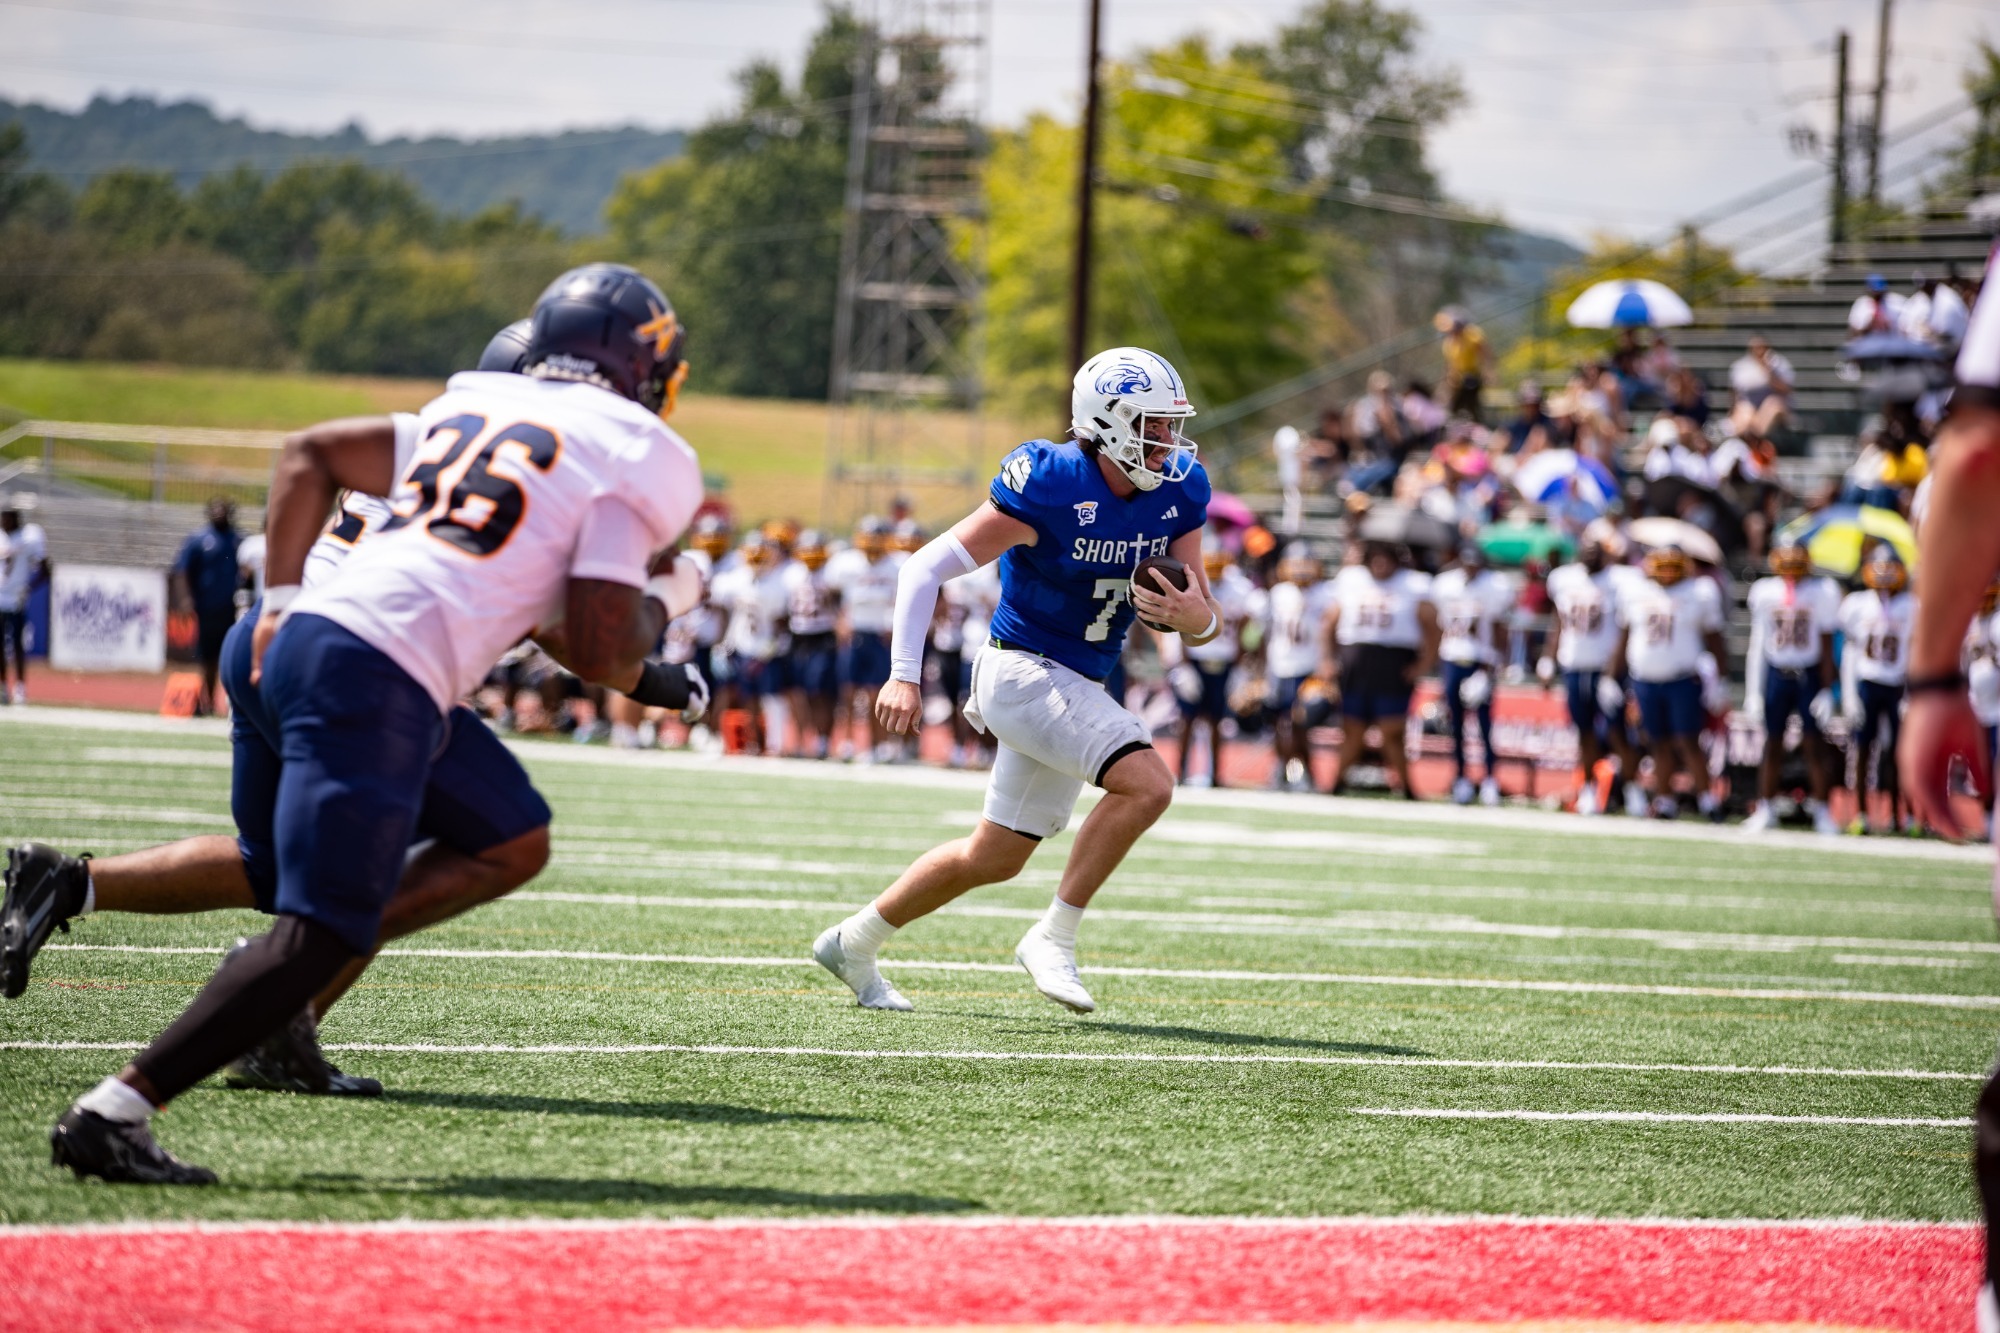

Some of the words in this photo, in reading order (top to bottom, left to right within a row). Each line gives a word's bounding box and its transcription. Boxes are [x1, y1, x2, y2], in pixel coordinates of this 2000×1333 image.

[377, 413, 562, 558] 36
[1071, 532, 1168, 566] SHORTER
[1084, 578, 1127, 641] 7
